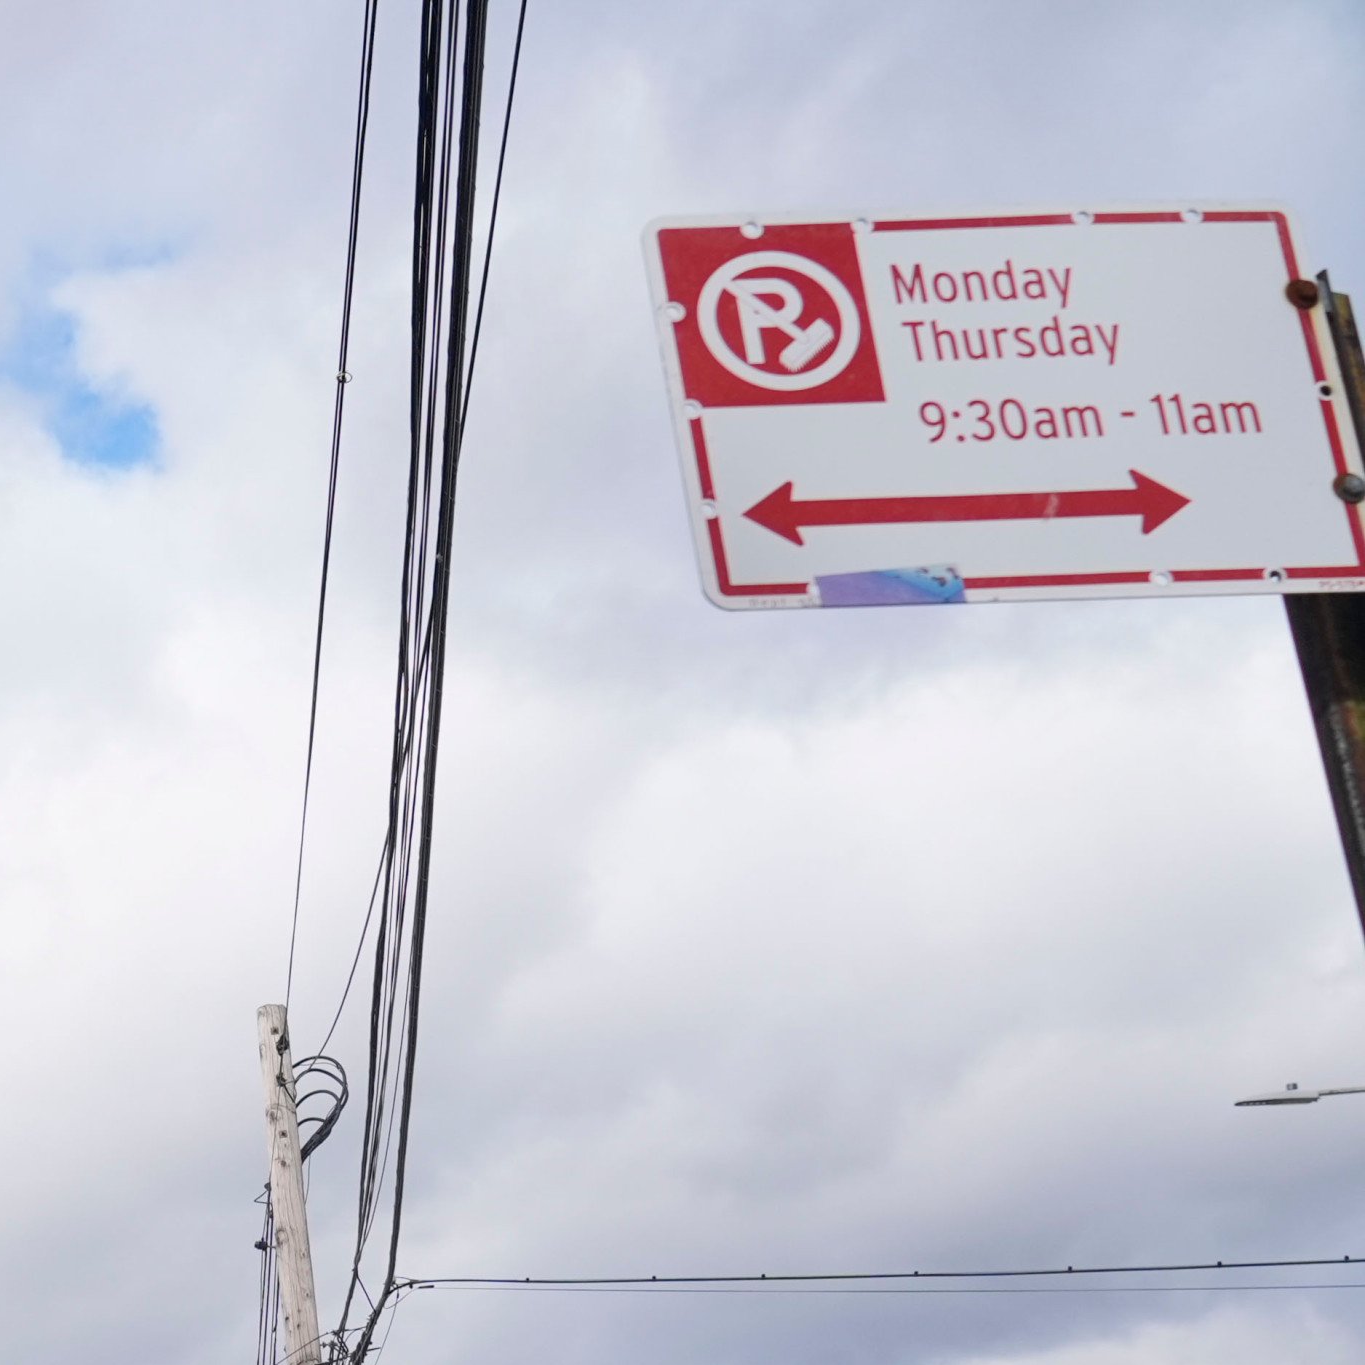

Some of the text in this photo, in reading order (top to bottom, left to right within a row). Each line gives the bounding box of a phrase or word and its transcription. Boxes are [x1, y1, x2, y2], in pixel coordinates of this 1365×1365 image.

[890, 259, 1072, 309] Monday
[902, 315, 1119, 366] Thursday
[919, 397, 1104, 444] 9:30am
[1150, 393, 1263, 436] 11am
